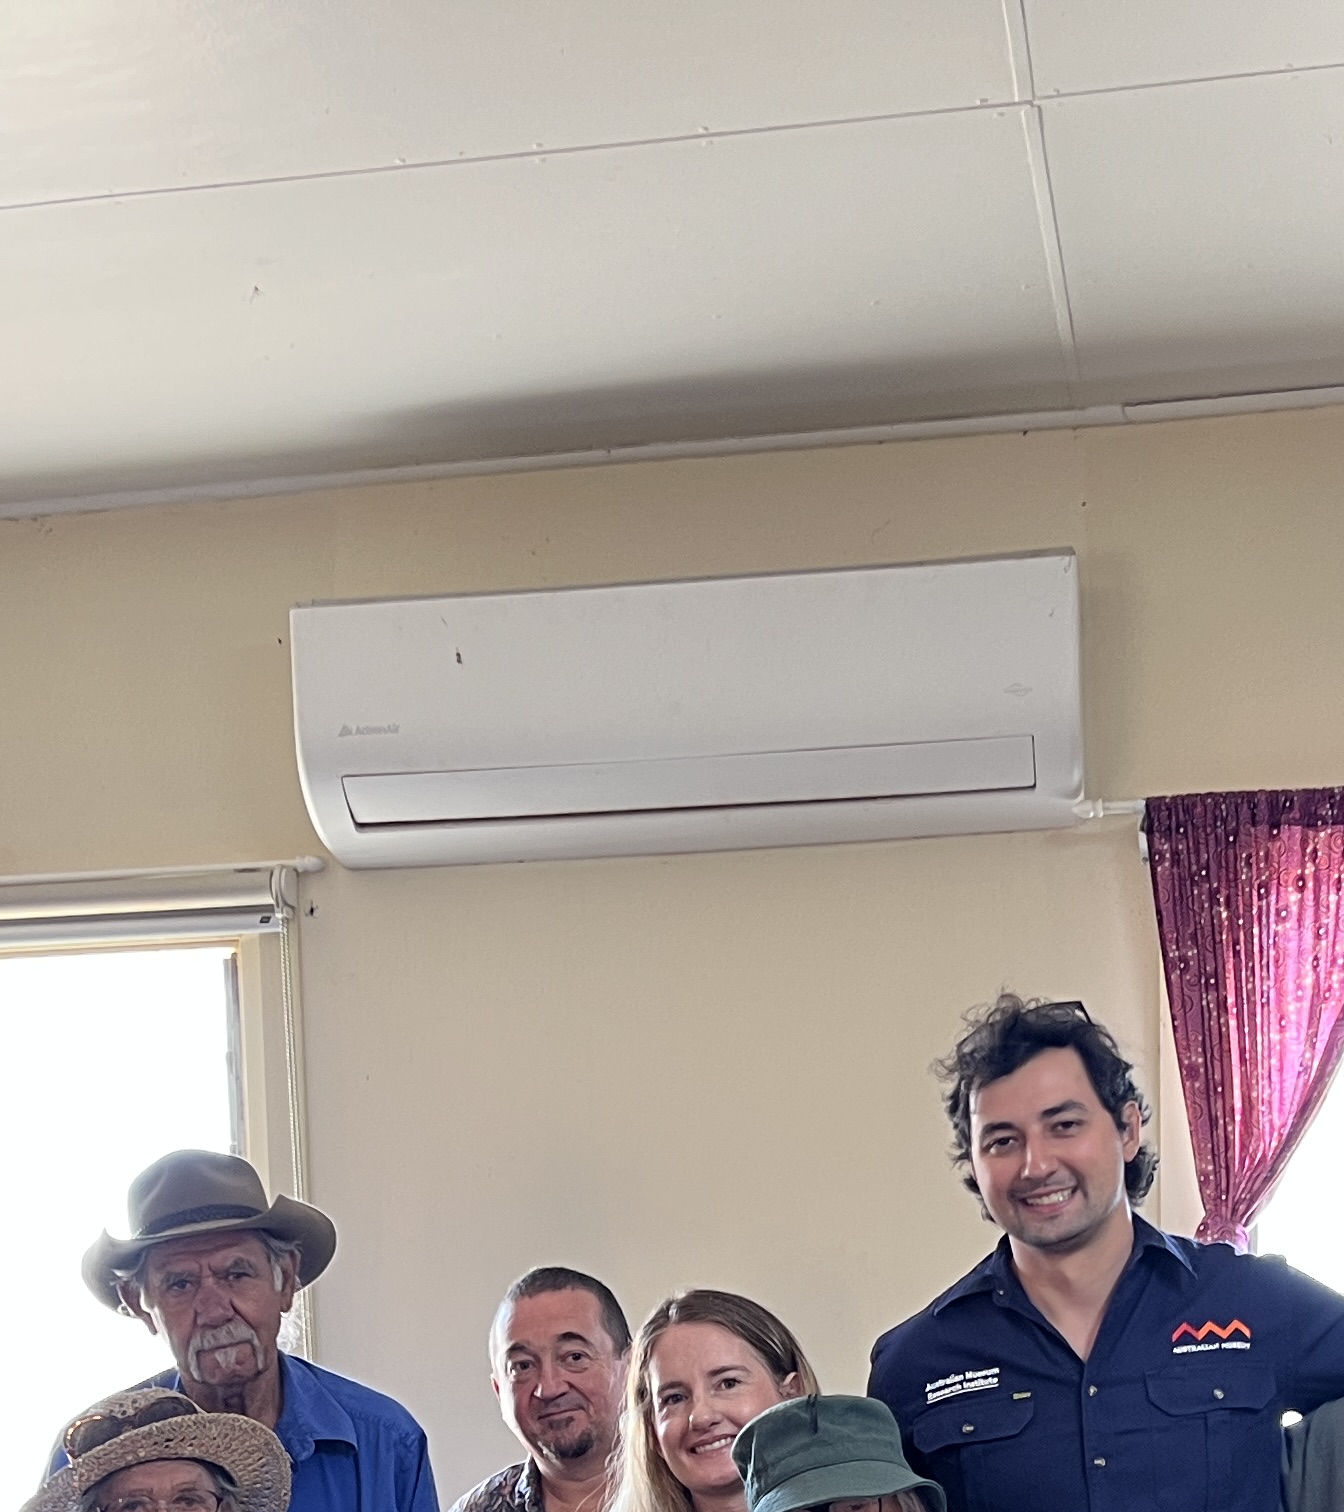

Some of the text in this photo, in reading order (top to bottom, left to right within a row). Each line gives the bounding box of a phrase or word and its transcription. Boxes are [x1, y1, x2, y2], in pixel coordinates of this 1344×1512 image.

[1172, 1342, 1220, 1354] AUSTRALIAN
[924, 1367, 1000, 1392] Australian Museum
[927, 1377, 999, 1401] Research Institute
